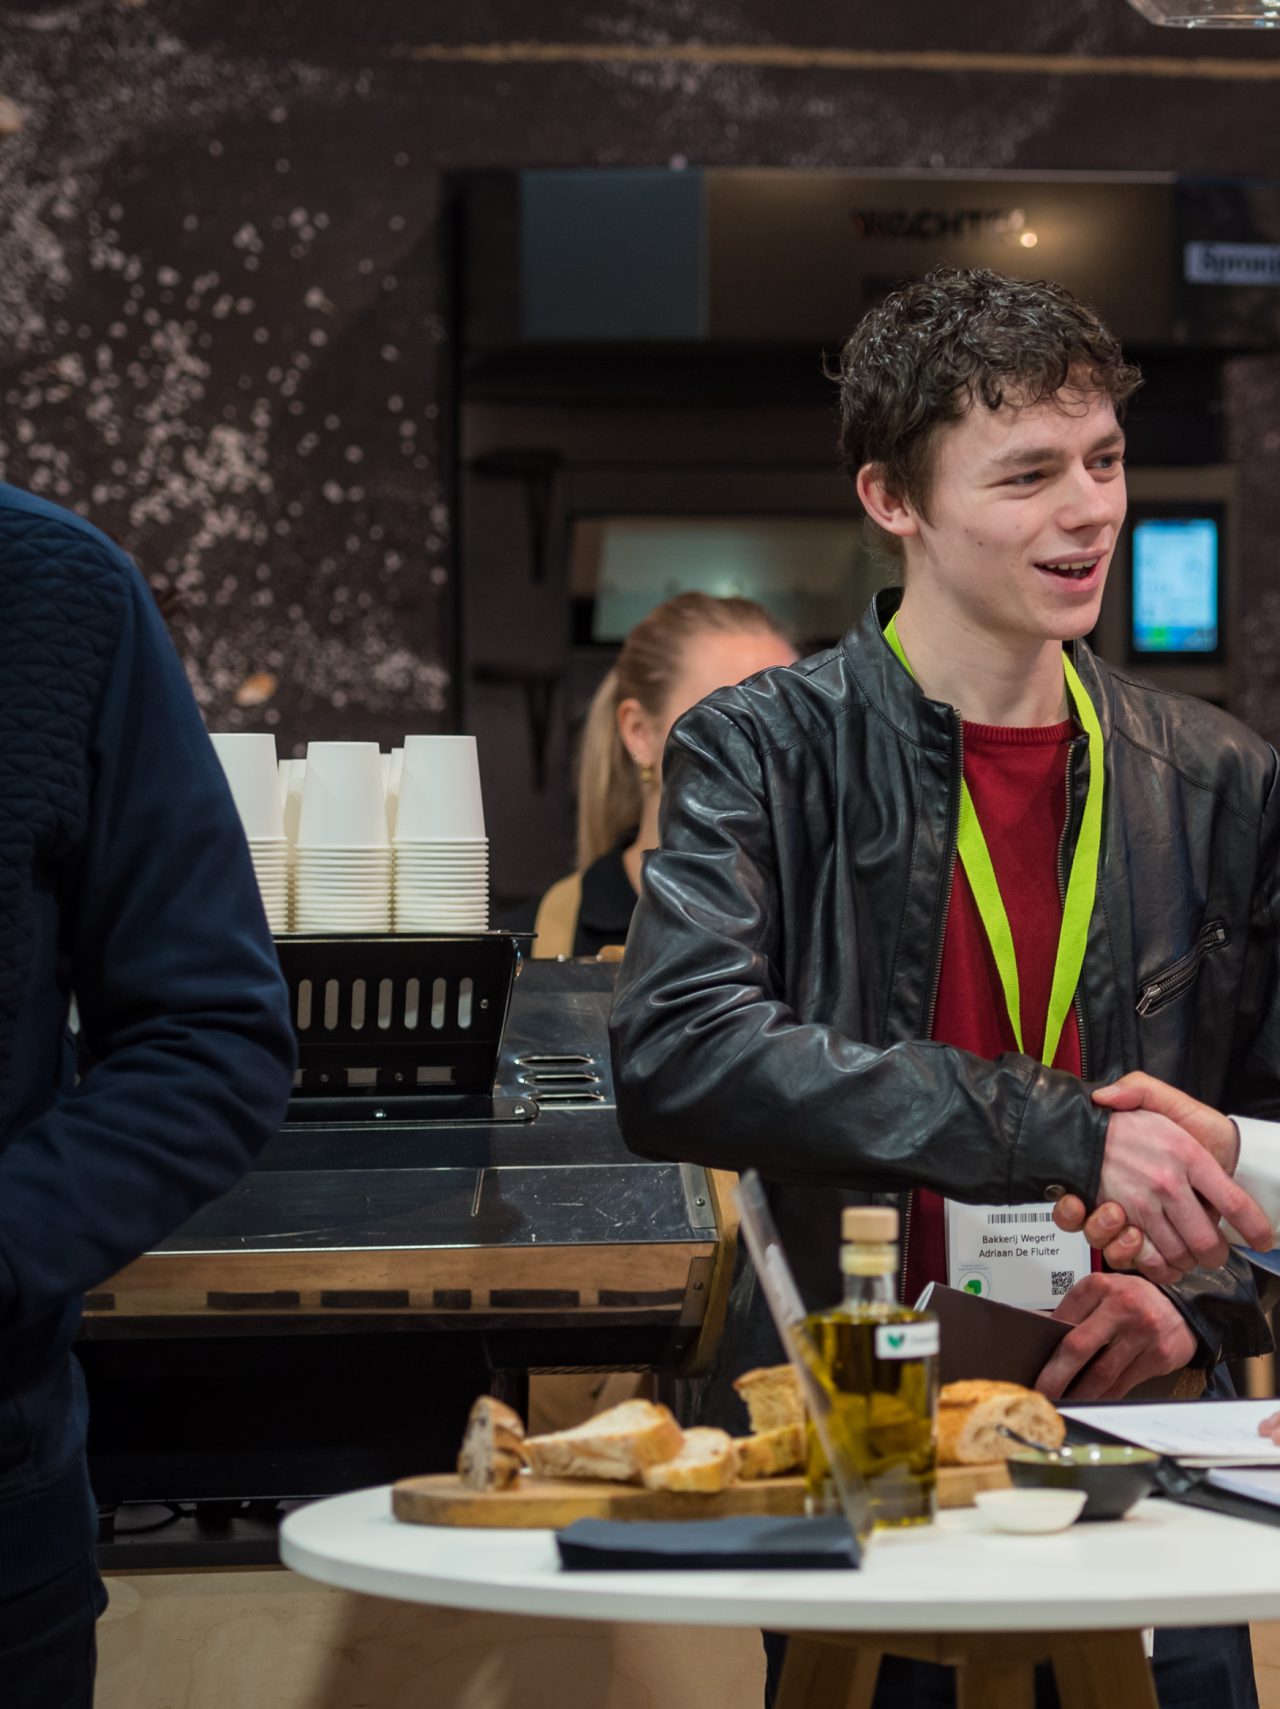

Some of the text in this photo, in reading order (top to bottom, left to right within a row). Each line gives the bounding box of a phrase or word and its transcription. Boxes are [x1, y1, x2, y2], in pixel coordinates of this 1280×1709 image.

[982, 1233, 1056, 1245] Bakkerij Wegerif
[979, 1248, 1060, 1258] Adriaan De Fluiter
